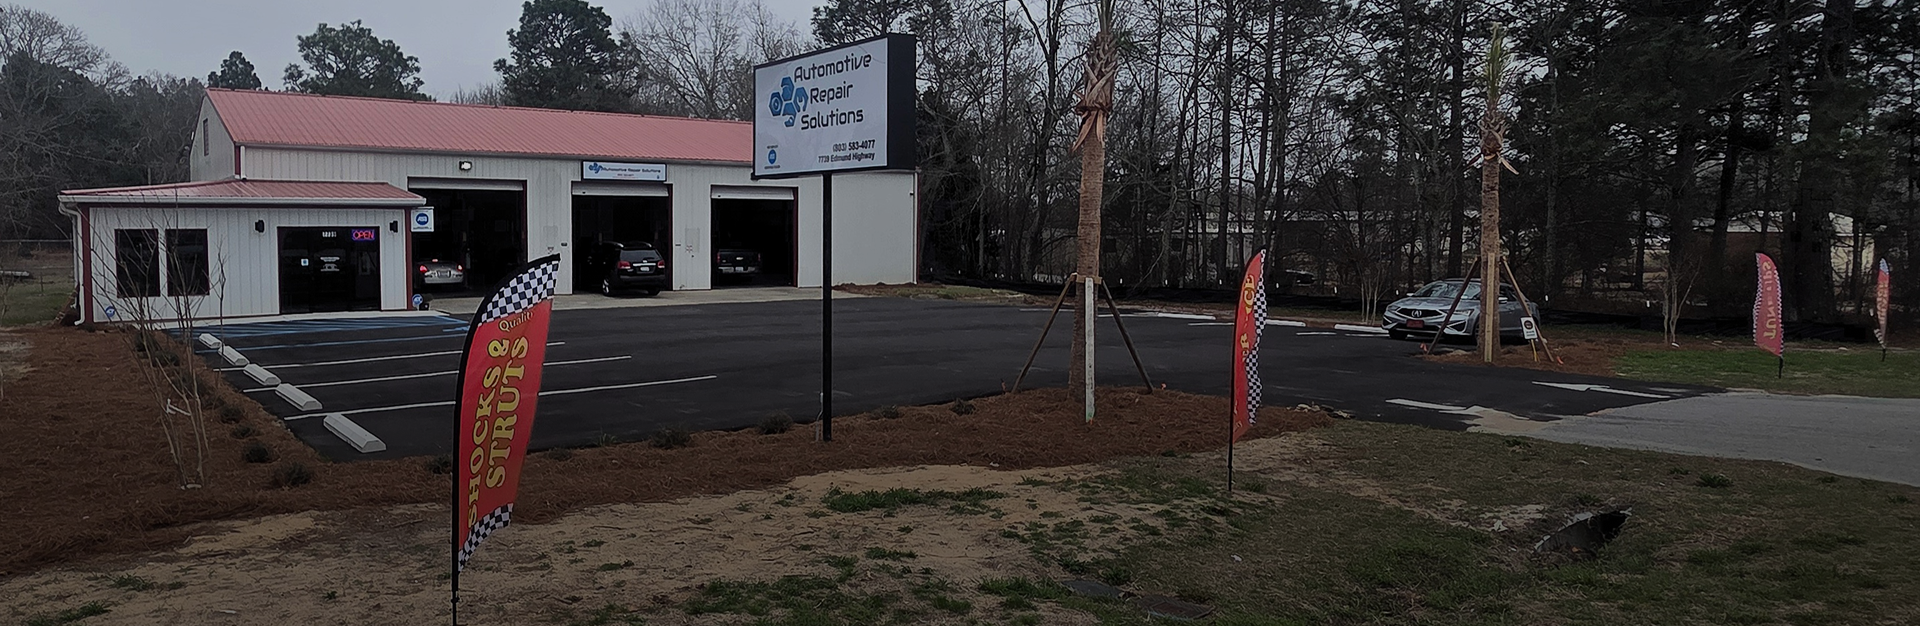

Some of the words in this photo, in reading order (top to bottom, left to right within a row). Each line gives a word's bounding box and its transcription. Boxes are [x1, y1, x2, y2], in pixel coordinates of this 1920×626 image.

[794, 53, 872, 83] Automotive
[810, 81, 853, 104] Repair
[801, 108, 864, 130] Solutions
[848, 139, 875, 151] 583-4077
[830, 153, 851, 162] Edmund
[852, 152, 875, 162] Highway
[352, 230, 375, 241] OPEN
[486, 336, 529, 488] STRUTS
[468, 365, 501, 528] SHOCKS
[487, 339, 510, 358] &
